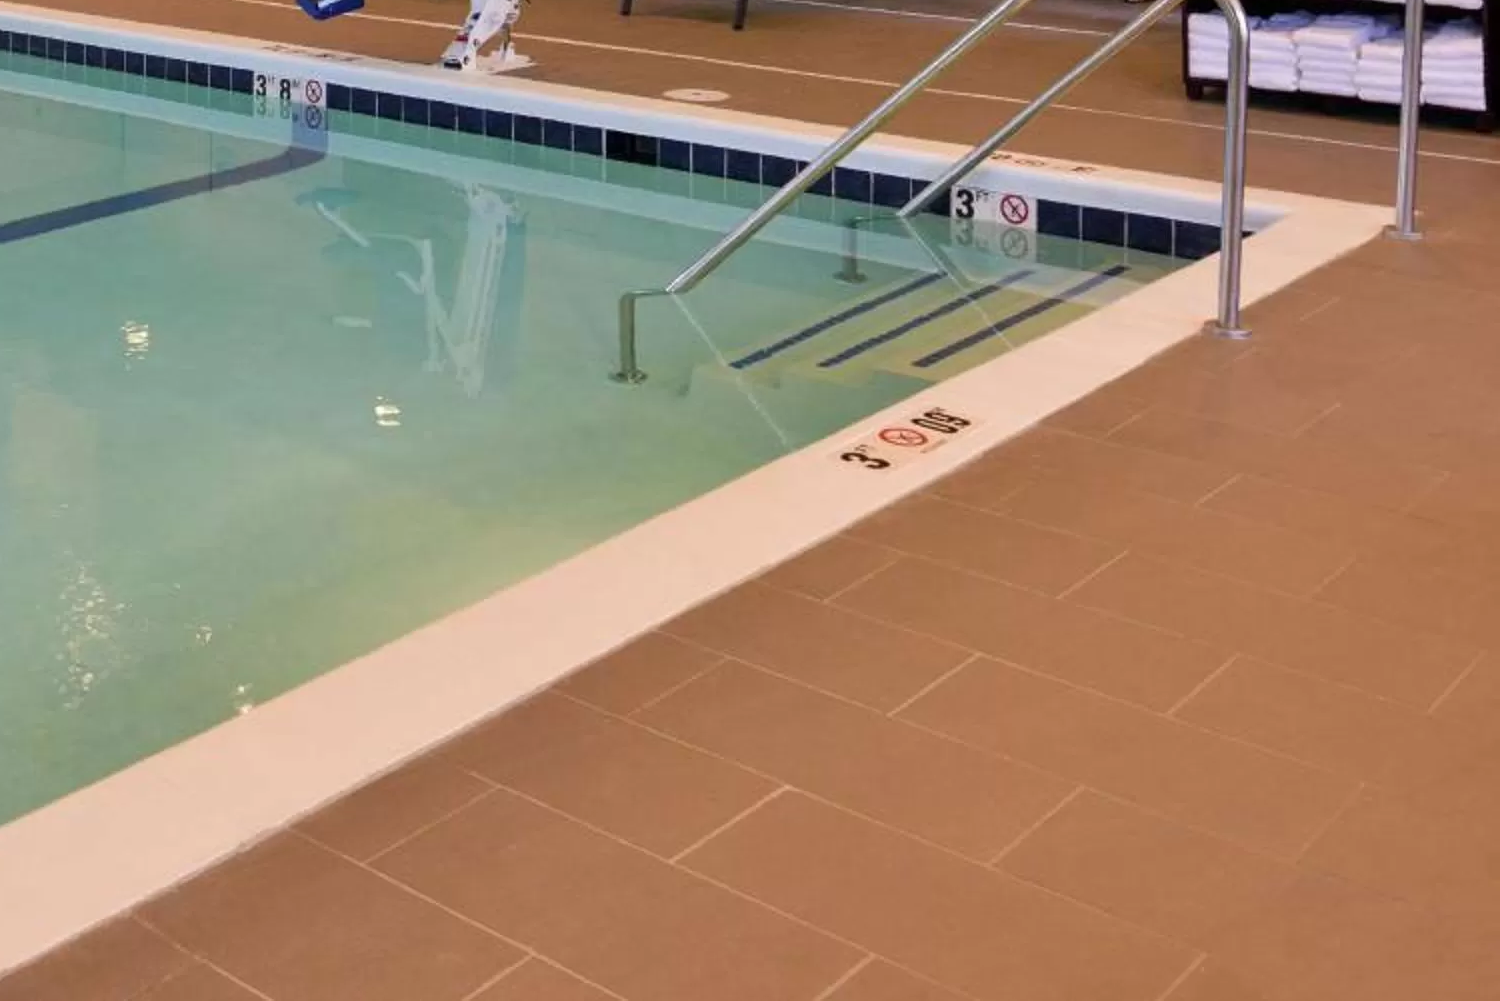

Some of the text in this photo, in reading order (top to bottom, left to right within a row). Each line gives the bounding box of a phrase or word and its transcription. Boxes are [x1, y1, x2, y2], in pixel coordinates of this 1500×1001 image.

[256, 74, 267, 96] 3
[280, 78, 291, 100] 8
[955, 188, 975, 219] 3
[839, 451, 891, 470] 3
